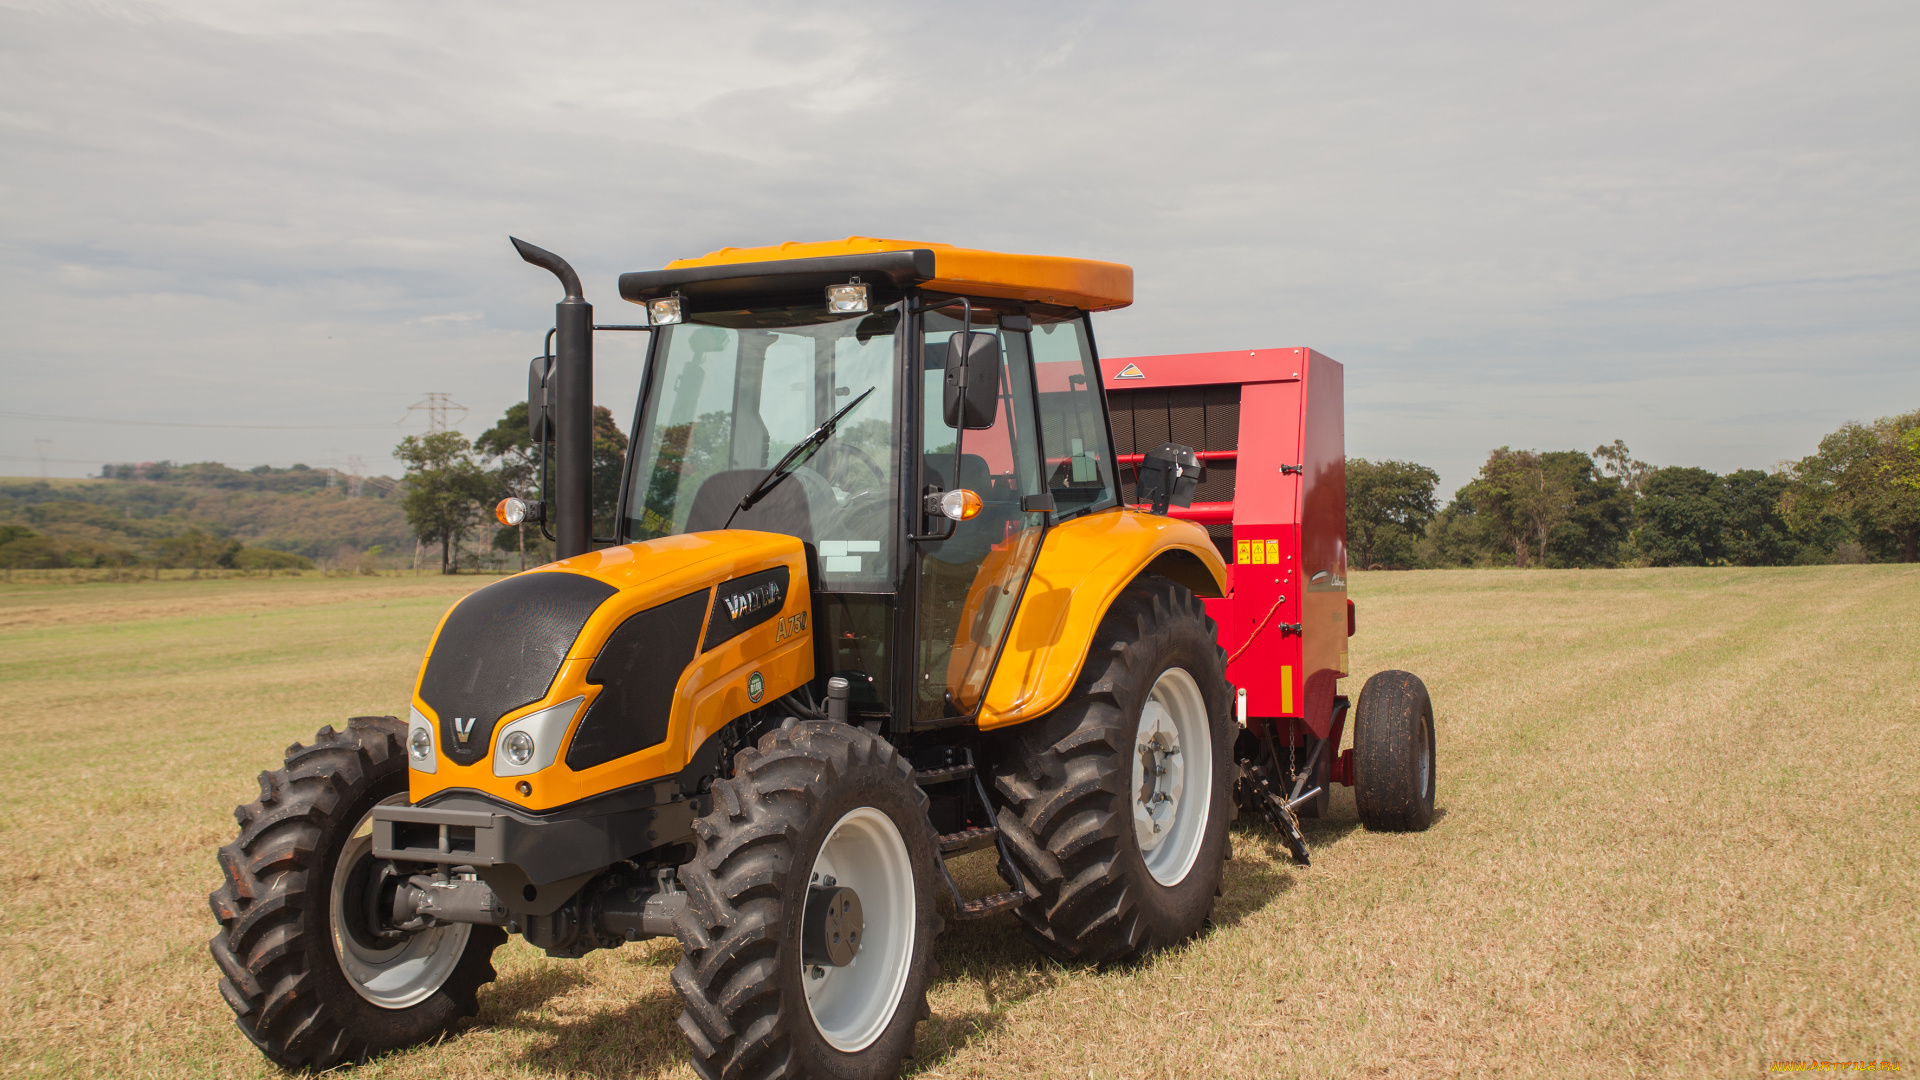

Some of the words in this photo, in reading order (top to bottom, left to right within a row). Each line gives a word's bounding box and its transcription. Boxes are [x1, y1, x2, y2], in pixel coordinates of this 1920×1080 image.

[723, 582, 780, 620] VALTRA
[776, 610, 808, 642] A750
[454, 717, 477, 743] V
